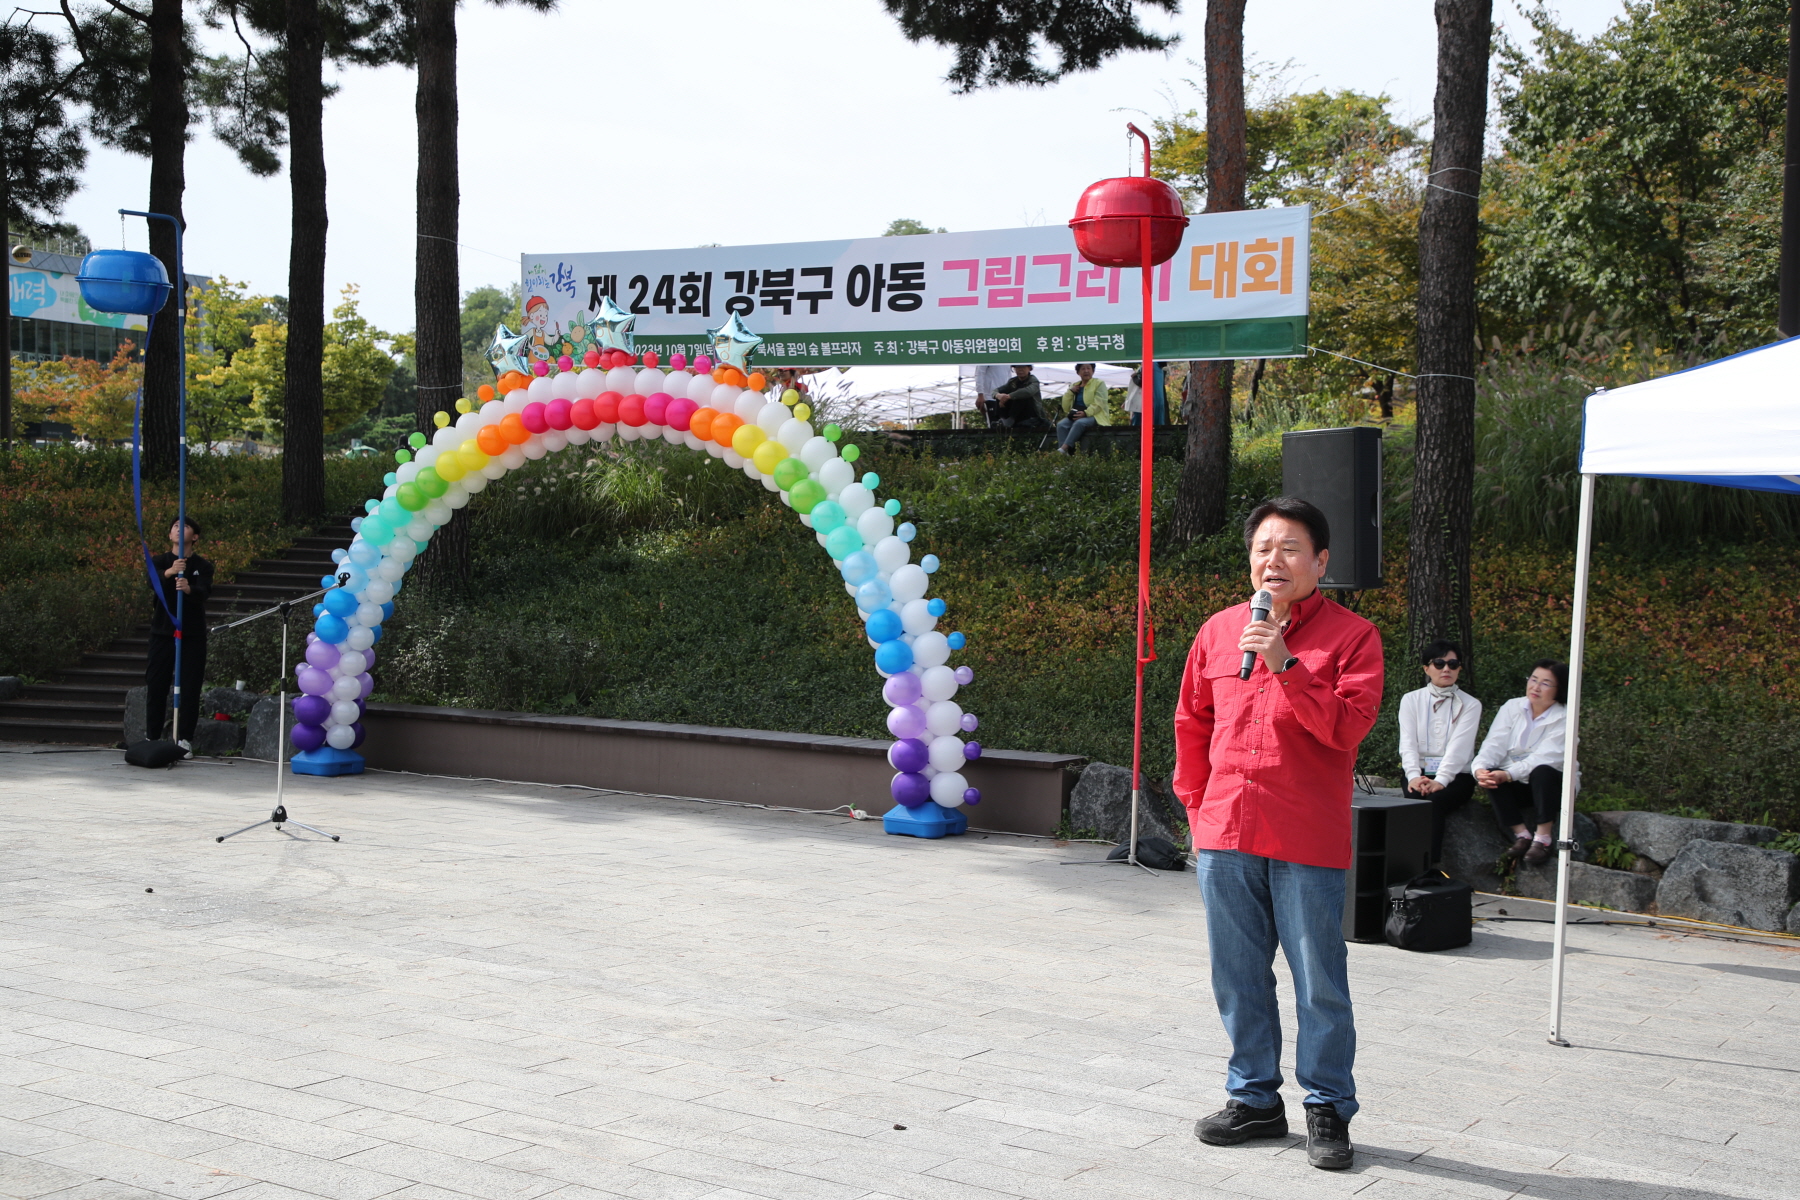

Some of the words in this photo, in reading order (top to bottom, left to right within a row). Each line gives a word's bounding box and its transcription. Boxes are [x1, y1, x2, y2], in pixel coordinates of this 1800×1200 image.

[549, 261, 577, 299] 강북
[587, 274, 617, 311] 제
[628, 271, 713, 318] 24회
[724, 266, 833, 317] 강북구
[846, 261, 926, 313] 아동
[937, 253, 1173, 309] 그림그리
[1189, 236, 1295, 299] 대회
[757, 342, 786, 357] 북서울
[787, 342, 807, 357] 꿈의
[808, 342, 819, 356] 숲
[820, 341, 862, 357] 볼프라자
[906, 339, 940, 355] 강북구
[941, 337, 1022, 355] 아동위원협의회
[1073, 333, 1126, 352] 강북구청
